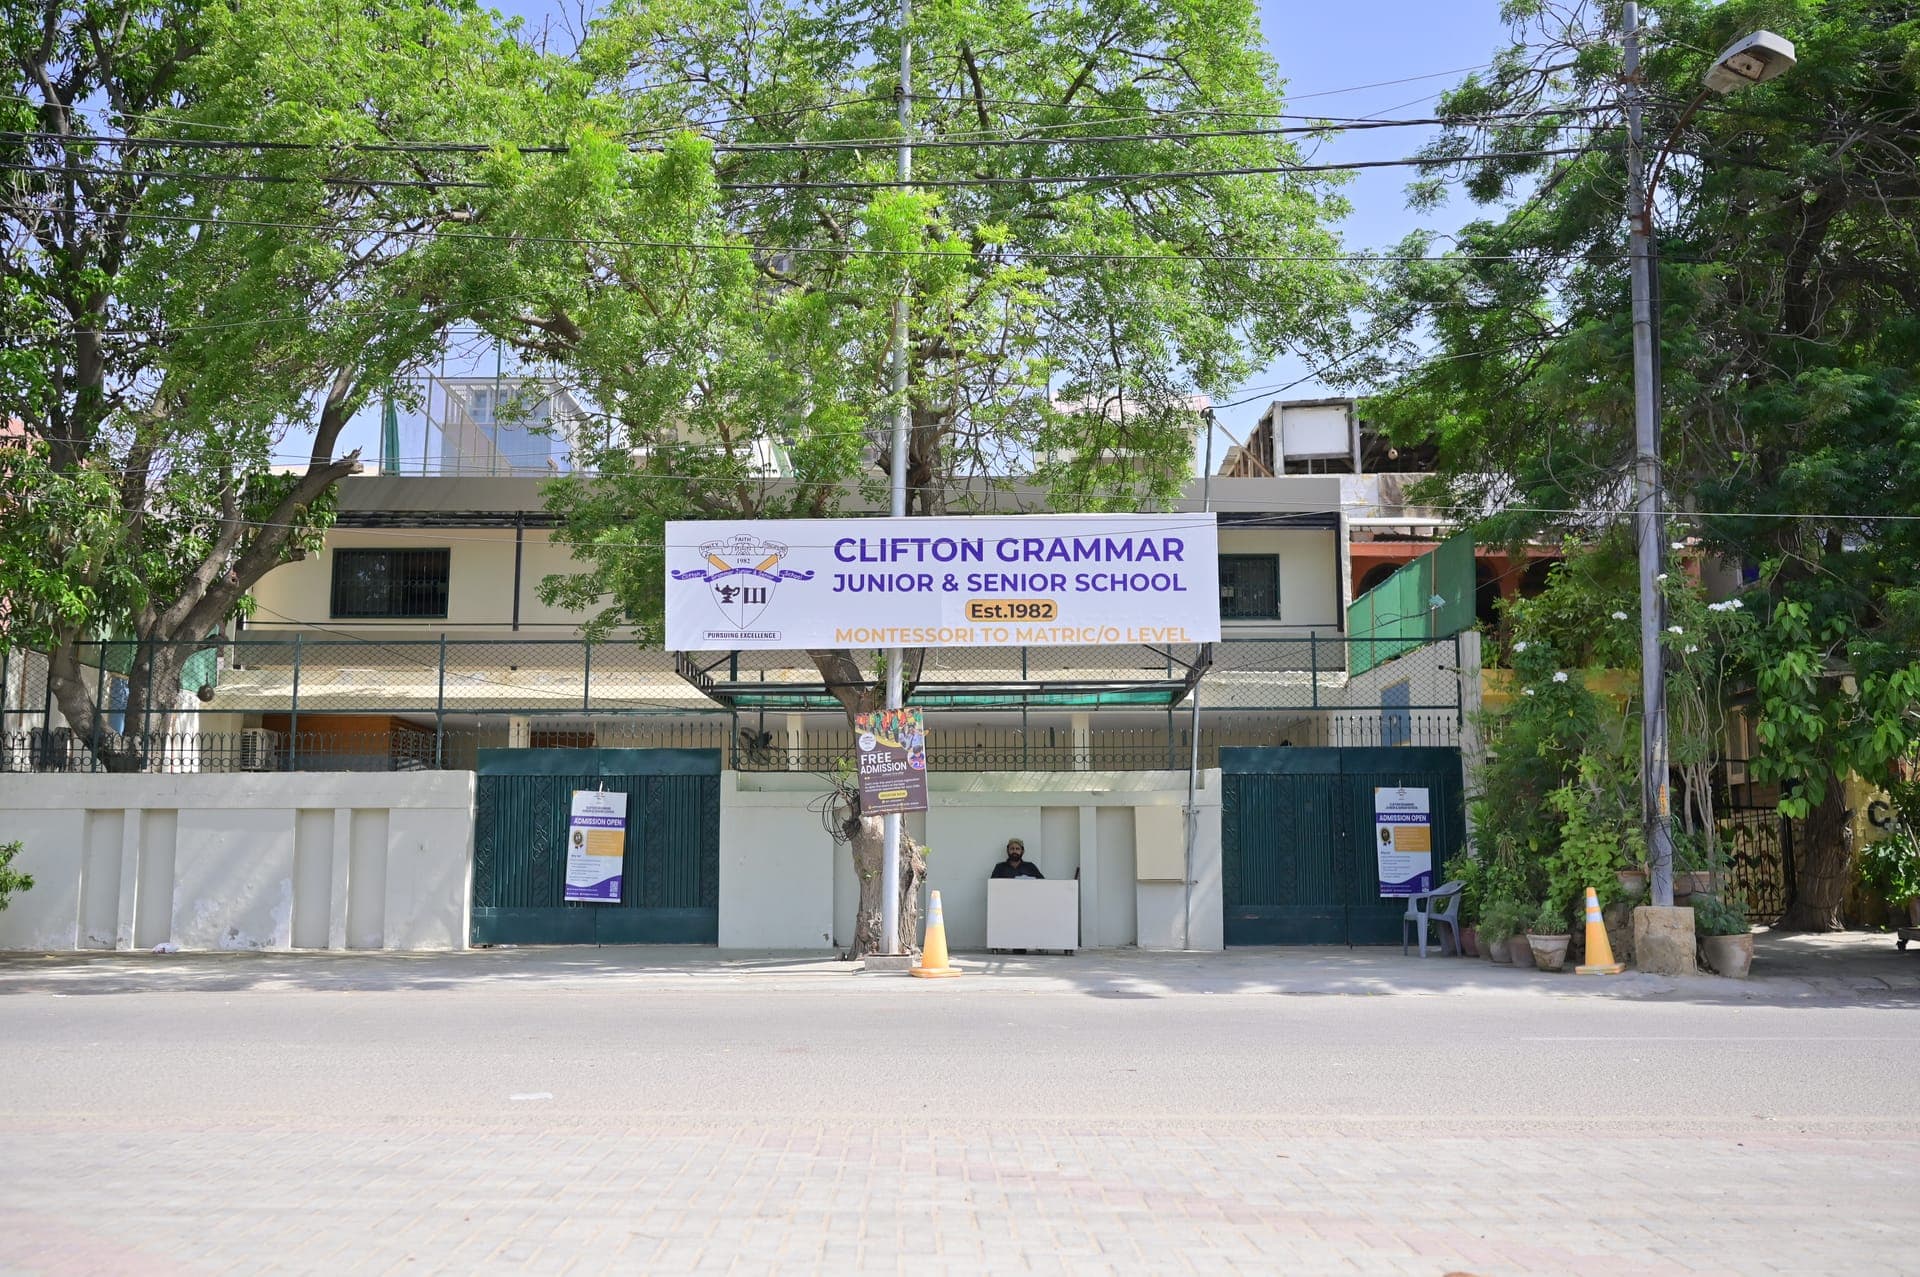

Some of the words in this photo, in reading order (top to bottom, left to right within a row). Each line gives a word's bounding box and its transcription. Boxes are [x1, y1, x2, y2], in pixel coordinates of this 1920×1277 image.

[834, 537, 984, 562] CLIFTON
[996, 537, 1184, 562] GRAMMAR
[833, 573, 933, 592] JUNIOR
[942, 573, 959, 592] &
[967, 573, 1067, 592] SENIOR
[1075, 573, 1187, 592] SCHOOL
[971, 603, 1053, 618] Est.1982
[835, 627, 974, 643] MONTESSORI
[980, 627, 1009, 643] TO
[1015, 625, 1120, 644] MATRIC/O
[1127, 627, 1191, 642] LEVEL
[860, 752, 892, 766] FREE
[860, 761, 907, 775] ADMISSION
[574, 817, 606, 825] ADMISSION
